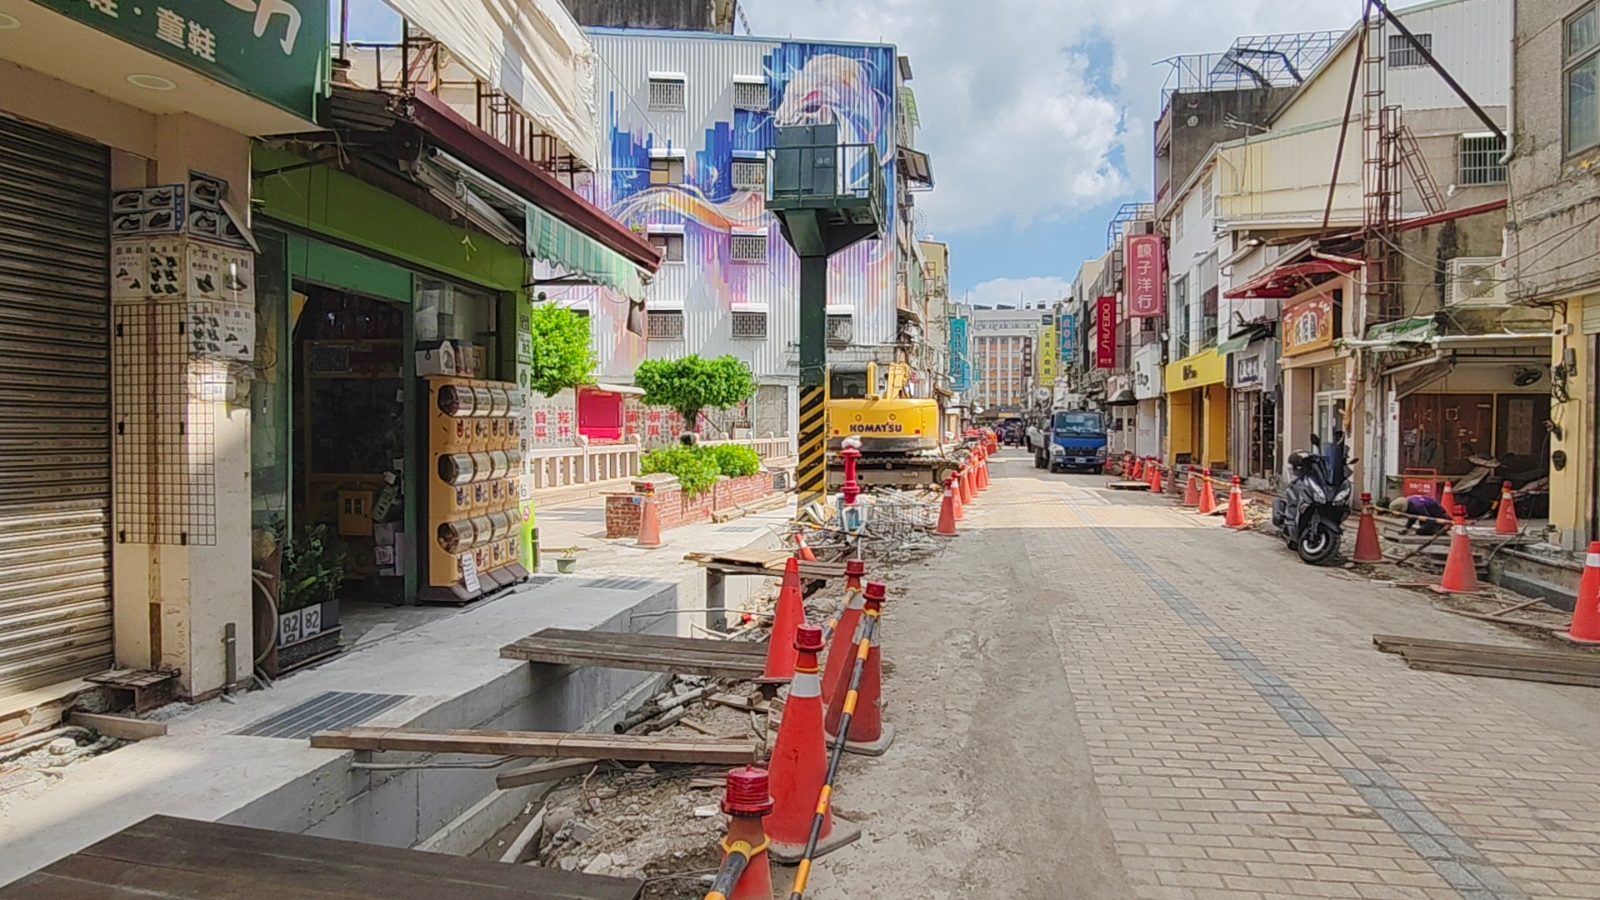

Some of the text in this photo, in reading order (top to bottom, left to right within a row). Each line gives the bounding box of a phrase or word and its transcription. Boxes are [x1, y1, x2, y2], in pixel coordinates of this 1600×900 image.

[849, 423, 903, 433] KOMATSU
[283, 615, 299, 634] 82
[305, 610, 319, 629] 82
